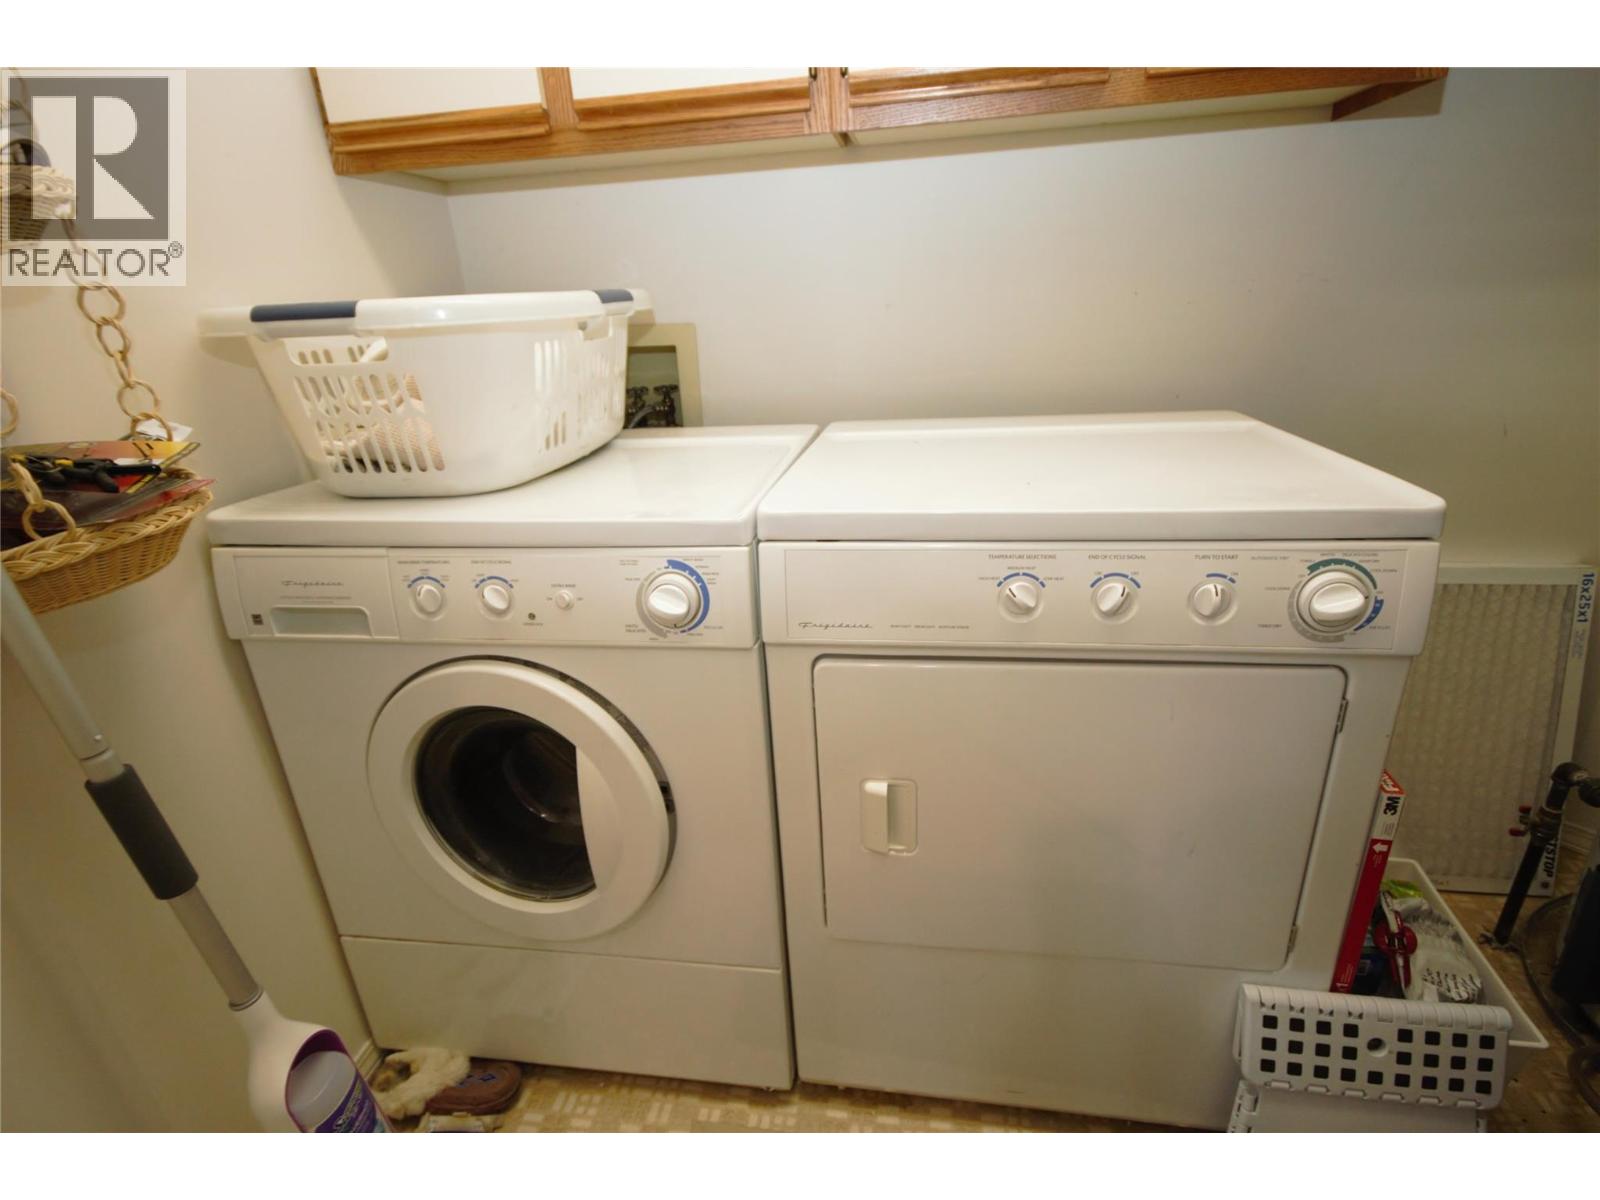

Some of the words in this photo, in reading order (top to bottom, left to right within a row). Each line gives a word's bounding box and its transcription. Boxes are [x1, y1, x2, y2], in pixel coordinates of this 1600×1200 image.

[1576, 572, 1595, 624] 16x25x1
[798, 622, 873, 630] Frigidaire
[1383, 795, 1400, 816] 3M
[1543, 838, 1559, 878] TSTOP
